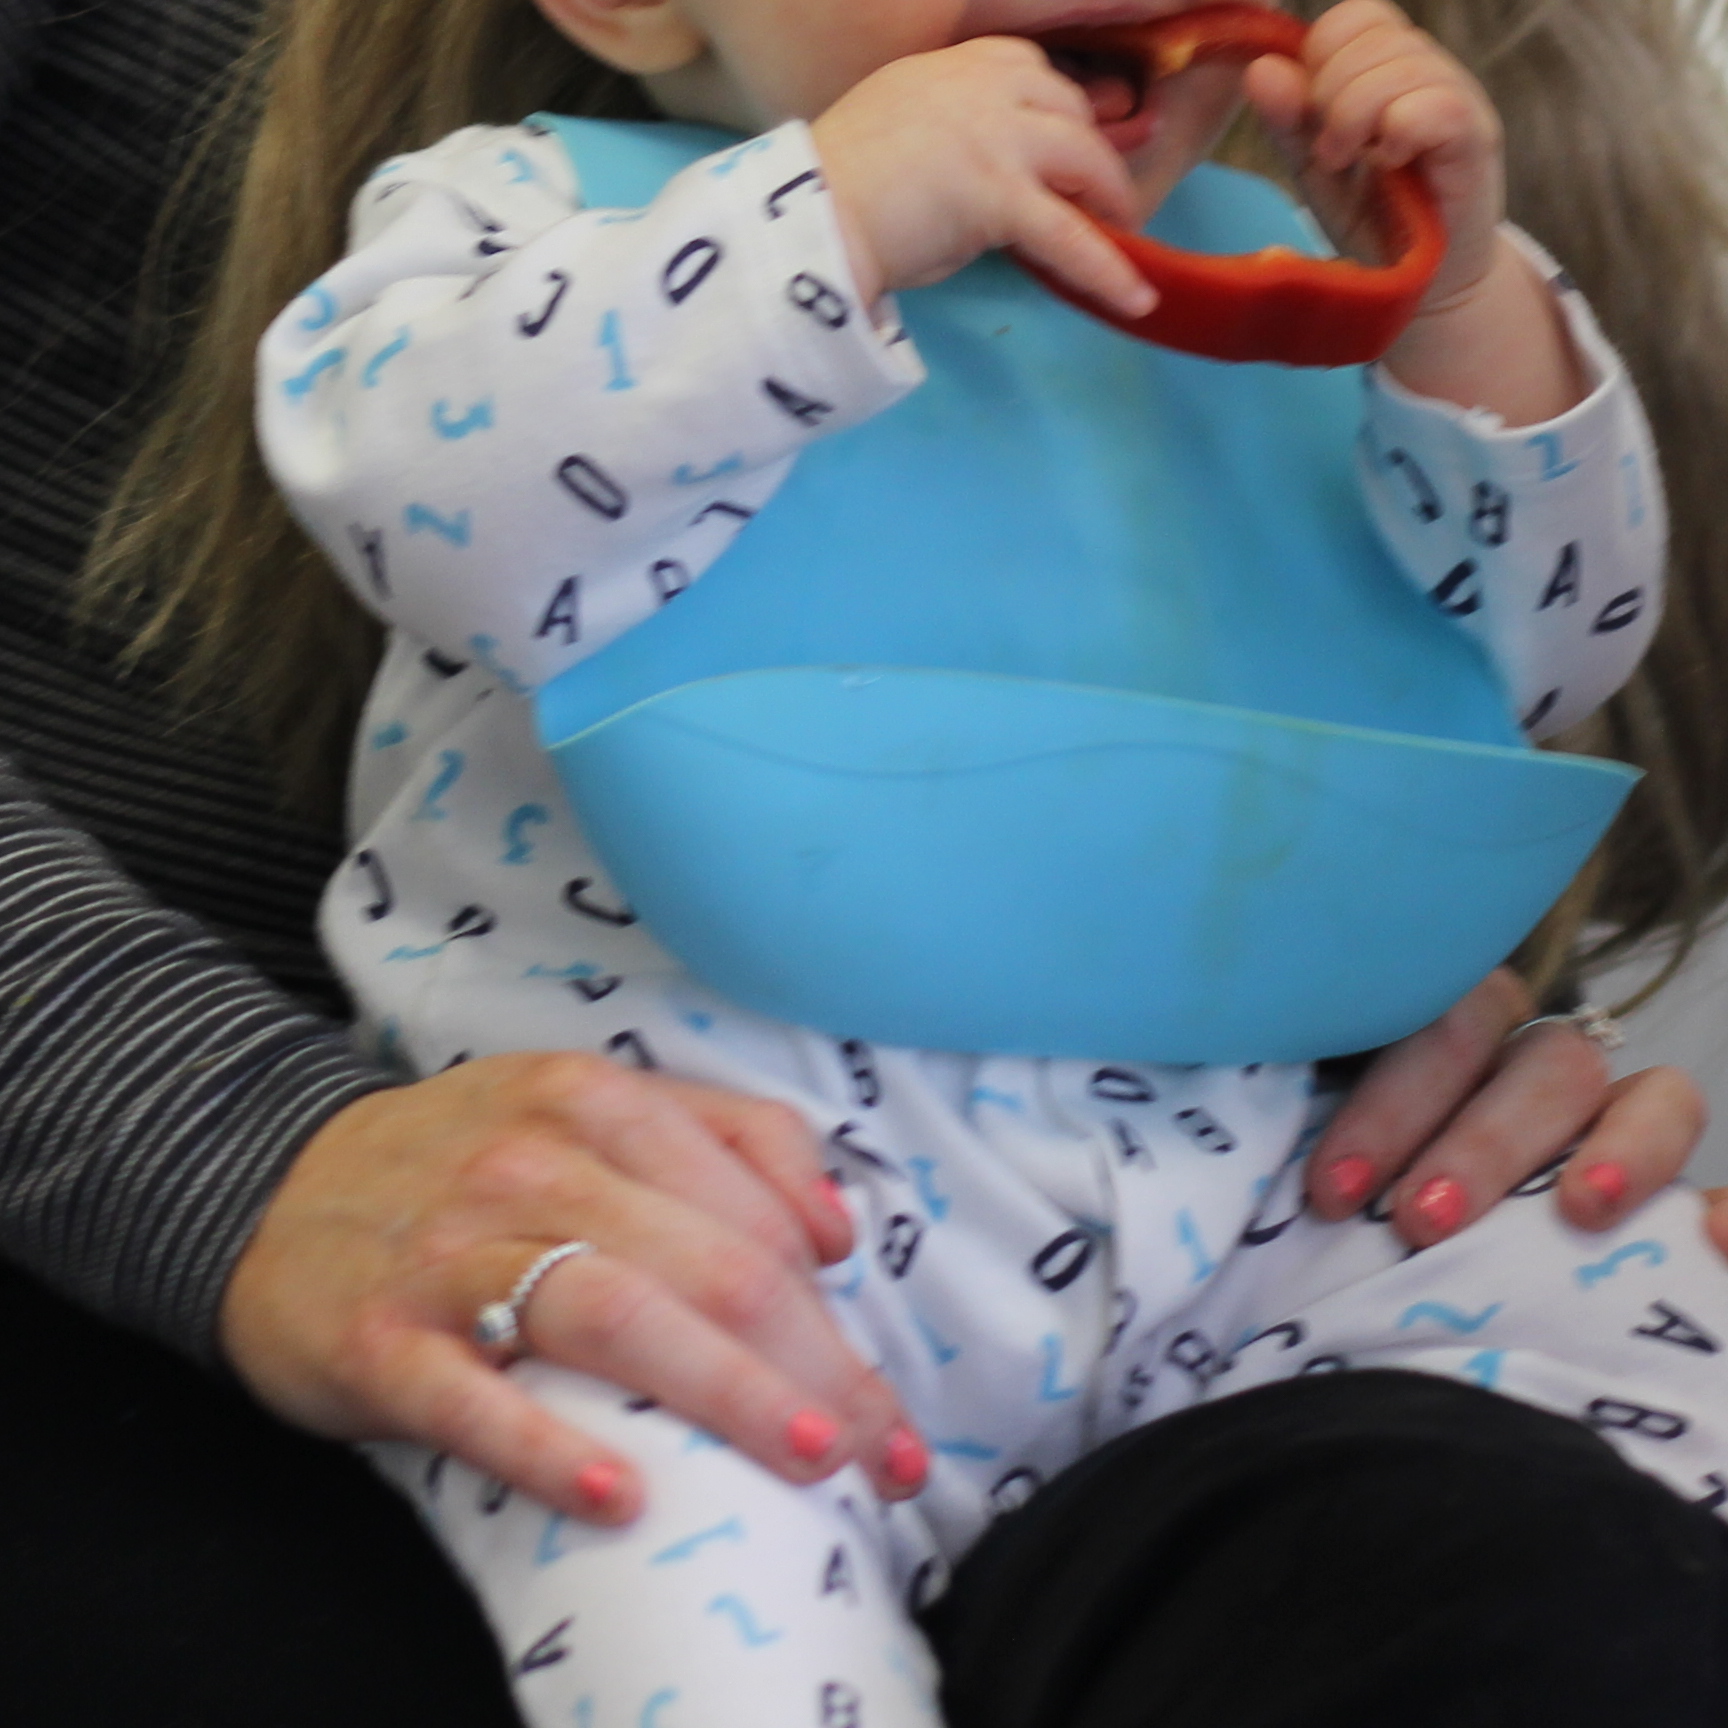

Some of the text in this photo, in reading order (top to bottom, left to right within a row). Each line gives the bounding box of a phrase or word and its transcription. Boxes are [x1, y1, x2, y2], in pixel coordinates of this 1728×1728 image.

[597, 309, 637, 392] 1
[1536, 541, 1581, 611] A
[535, 576, 579, 643] A
[1631, 1299, 1724, 1354] A
[1584, 1397, 1691, 1440] B
[706, 1594, 784, 1647] 2
